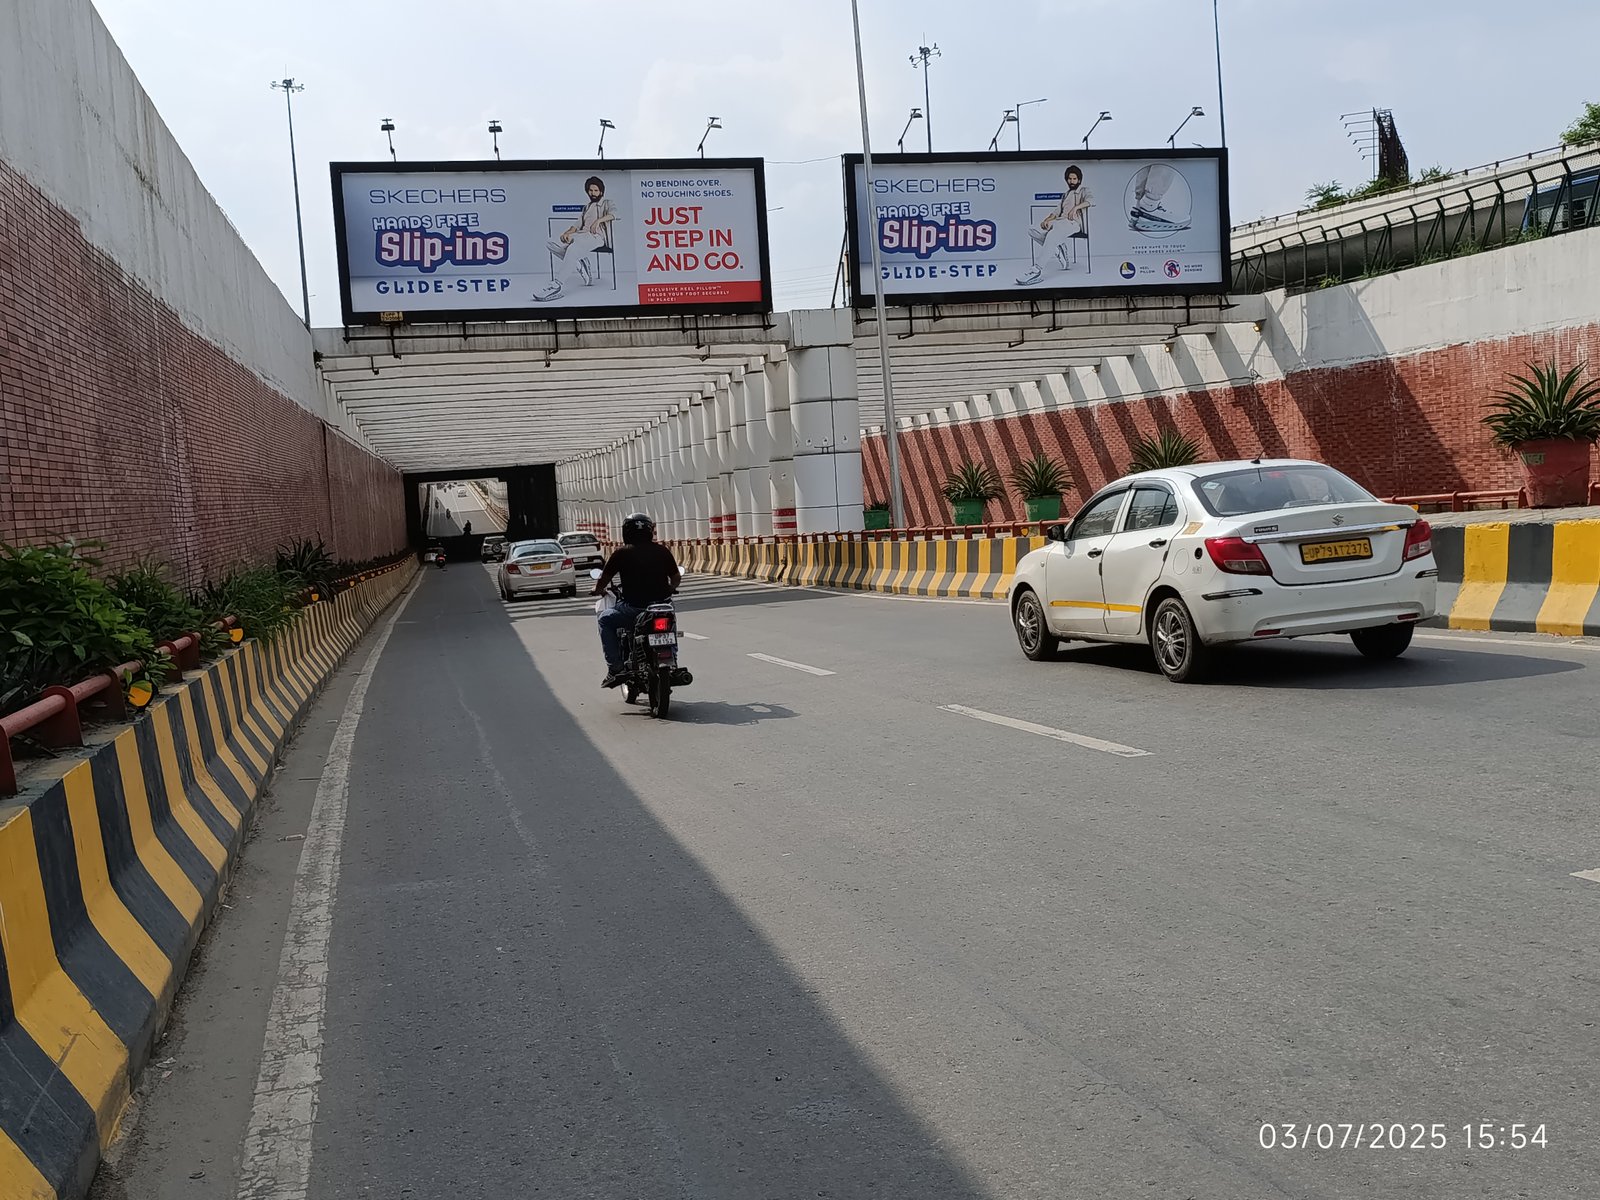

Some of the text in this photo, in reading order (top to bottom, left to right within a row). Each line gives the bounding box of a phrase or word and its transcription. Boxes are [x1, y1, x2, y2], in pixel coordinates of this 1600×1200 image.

[640, 179, 722, 188] NO BENDING OVER.
[874, 178, 996, 194] SKECHERS
[369, 188, 507, 204] SKECHERS
[656, 190, 702, 198] TOUCHING
[703, 189, 734, 197] SHOES.
[644, 206, 703, 226] JUST
[876, 201, 970, 219] HANDS FREE
[373, 213, 479, 231] HANDS FREE
[645, 228, 733, 249] STEP IN
[881, 218, 995, 256] Slip-ins
[379, 229, 506, 270] Slip-ins
[647, 251, 744, 272] AND GO.
[376, 279, 511, 295] GLIDE-STEP
